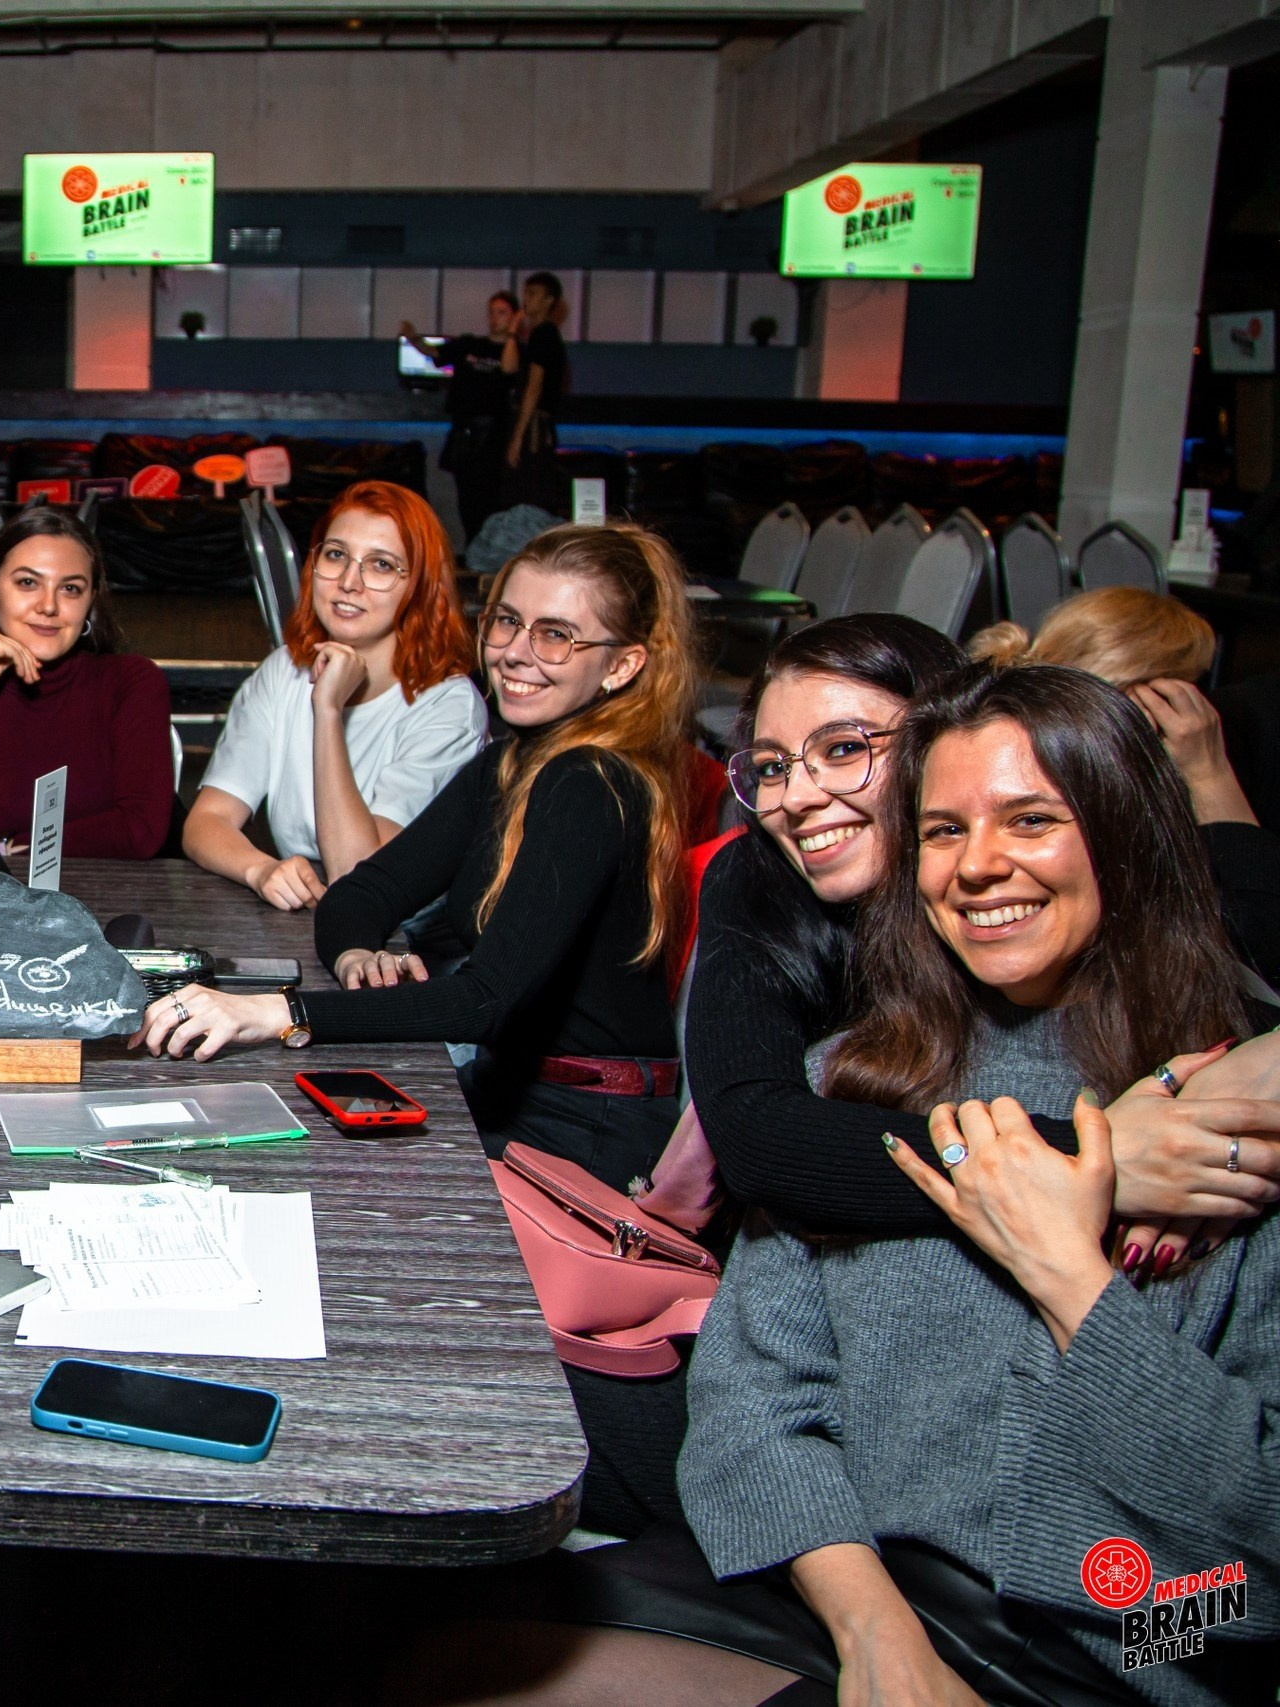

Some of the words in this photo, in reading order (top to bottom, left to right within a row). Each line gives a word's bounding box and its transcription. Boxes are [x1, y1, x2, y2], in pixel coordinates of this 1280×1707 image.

[82, 188, 150, 225] BRAIN
[844, 201, 916, 236] BRAIN
[82, 216, 126, 238] BATTLE
[843, 228, 889, 250] BATTLE
